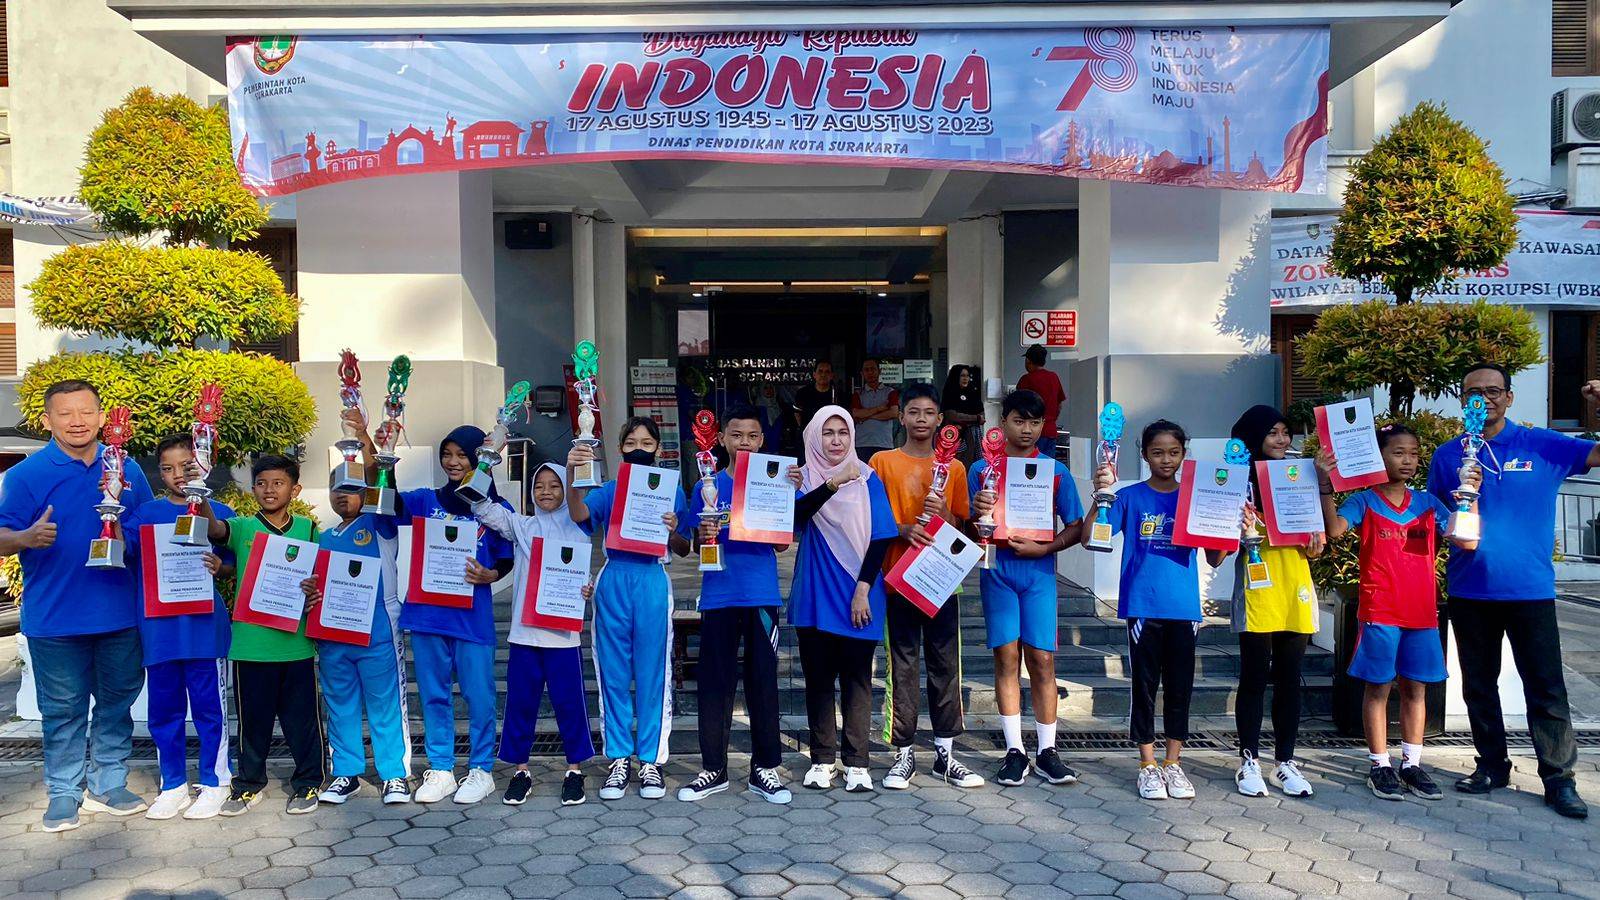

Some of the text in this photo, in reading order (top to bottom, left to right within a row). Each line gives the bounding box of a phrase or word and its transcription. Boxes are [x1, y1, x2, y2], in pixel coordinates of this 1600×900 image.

[1151, 30, 1202, 42] TERUS
[1151, 45, 1215, 60] MELAJU
[1151, 61, 1204, 77] UNTUK
[243, 76, 306, 95] PEMERINTAH KOTA
[567, 53, 991, 113] INDONESIA
[1152, 77, 1236, 94] INDONESIA
[255, 86, 293, 101] SURAKARTA
[1152, 93, 1194, 109] MAJU
[566, 116, 594, 131] 17
[596, 110, 710, 130] AGUSTUS
[715, 110, 771, 129] 1945
[790, 113, 818, 131] 17
[822, 113, 933, 132] AGUSTUS
[937, 116, 994, 134] 2023
[649, 137, 909, 154] DINAS PENDIDIKAN KOTA SURAKARTA
[1271, 282, 1356, 300] WILAYAH
[1465, 283, 1551, 297] KORUPSI
